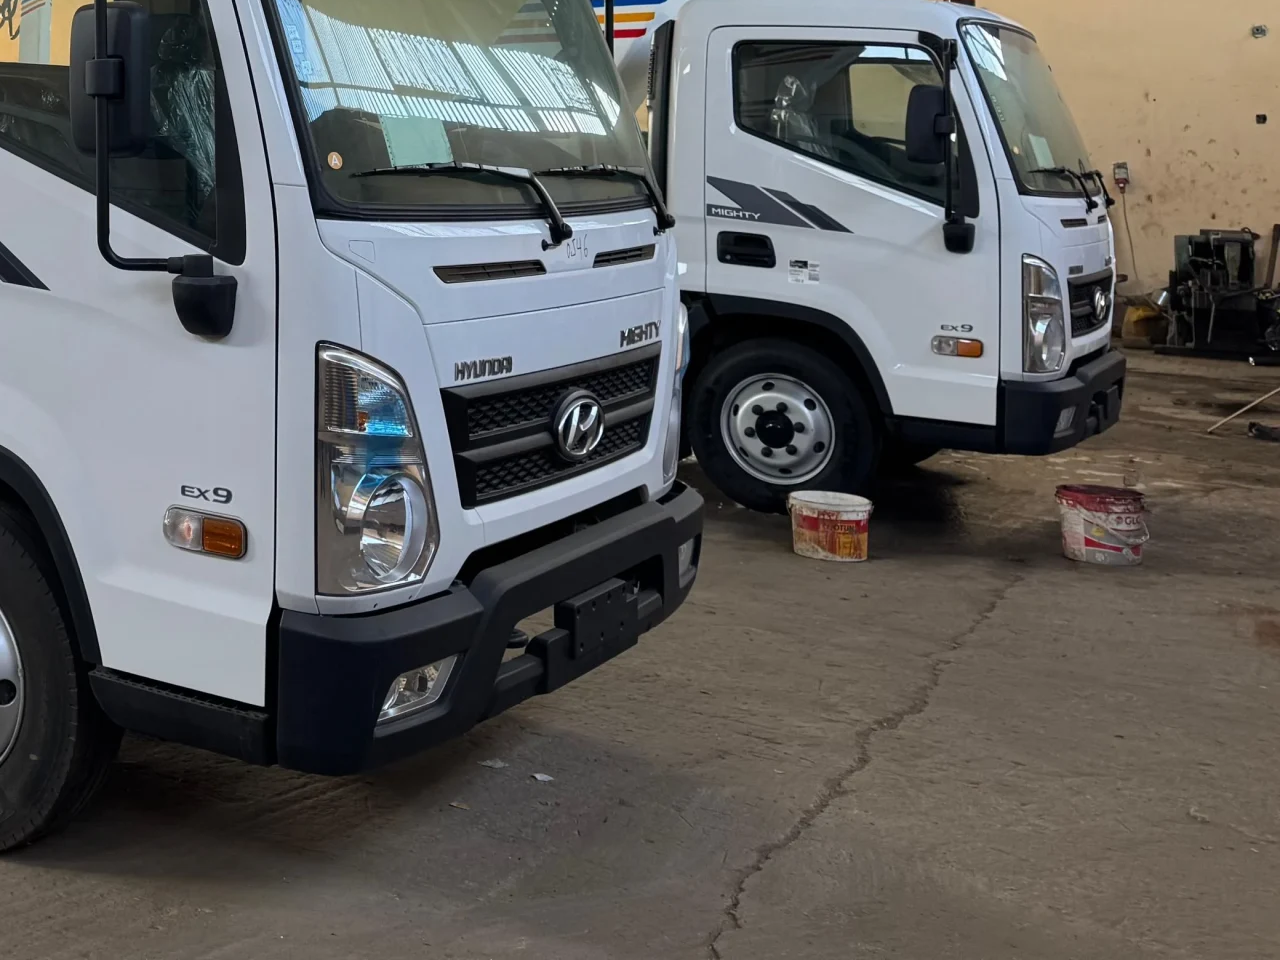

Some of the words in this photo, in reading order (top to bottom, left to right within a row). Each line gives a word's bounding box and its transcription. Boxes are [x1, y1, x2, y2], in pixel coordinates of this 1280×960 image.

[711, 207, 761, 220] MIGHTY
[620, 320, 661, 348] MIGHTY
[454, 355, 513, 382] HYUNDAI
